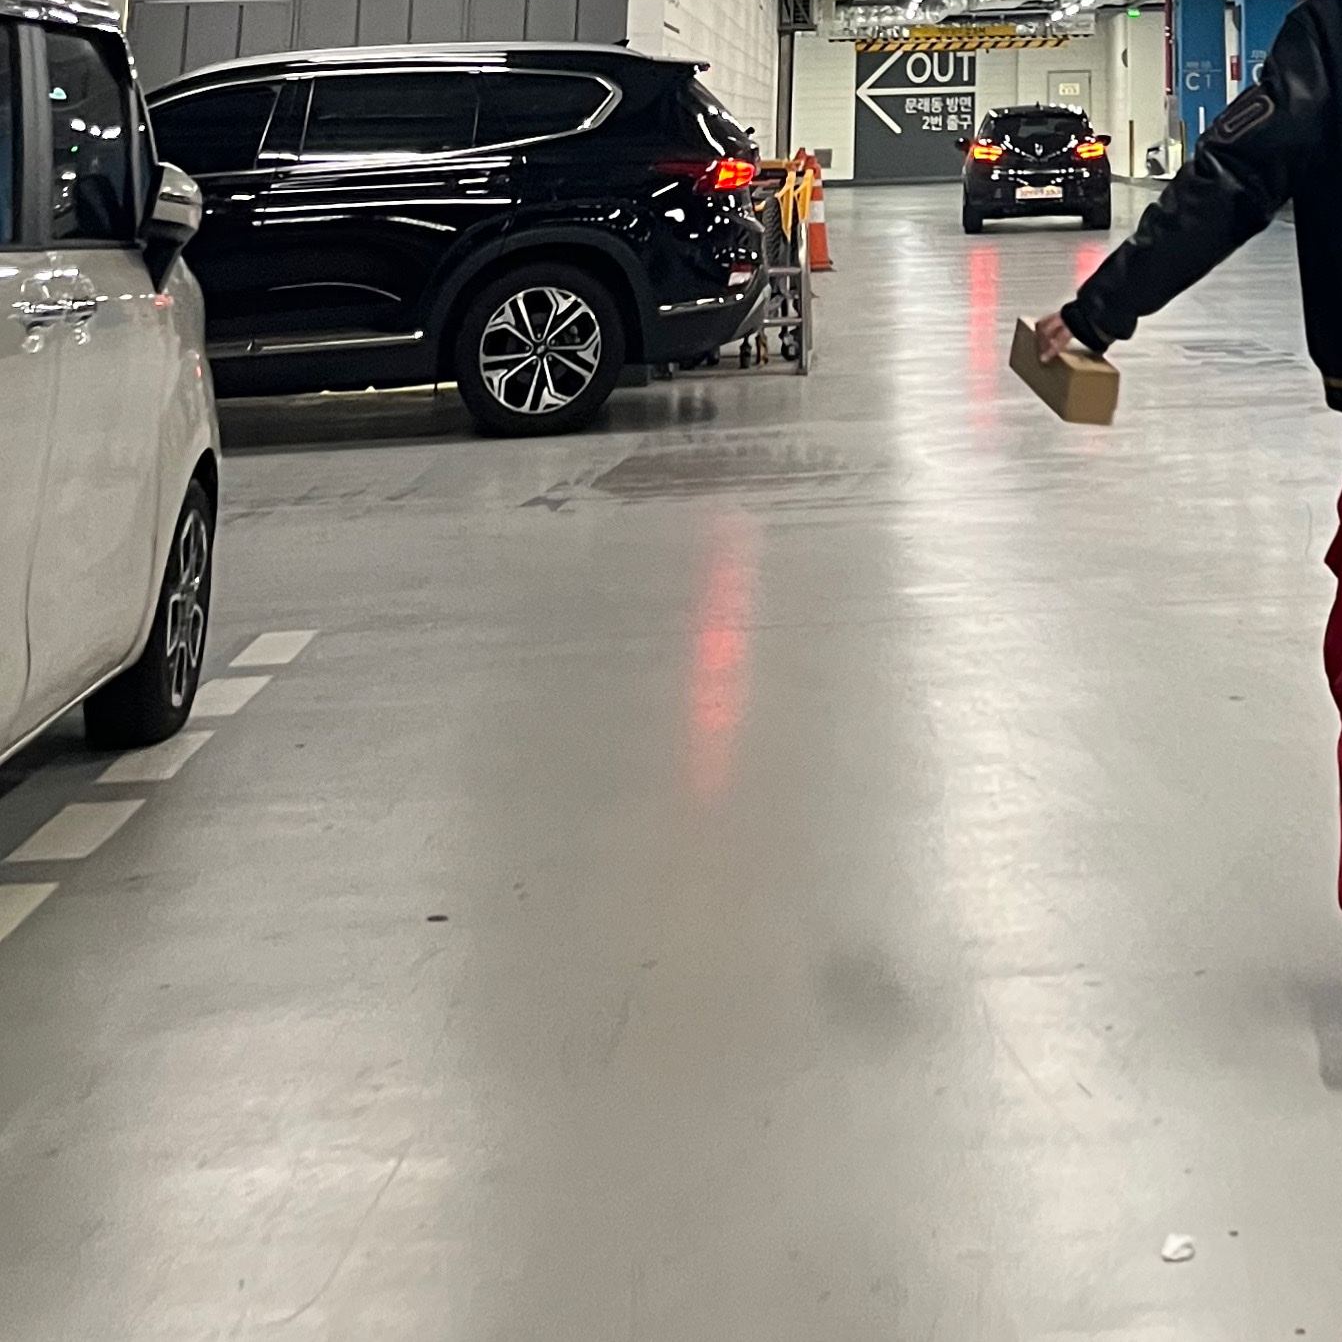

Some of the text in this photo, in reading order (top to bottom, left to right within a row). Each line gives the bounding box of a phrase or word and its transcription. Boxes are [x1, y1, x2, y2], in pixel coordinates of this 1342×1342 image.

[906, 52, 975, 84] OUT
[905, 96, 972, 114] 문래동 방면
[922, 114, 972, 131] 2번 출구
